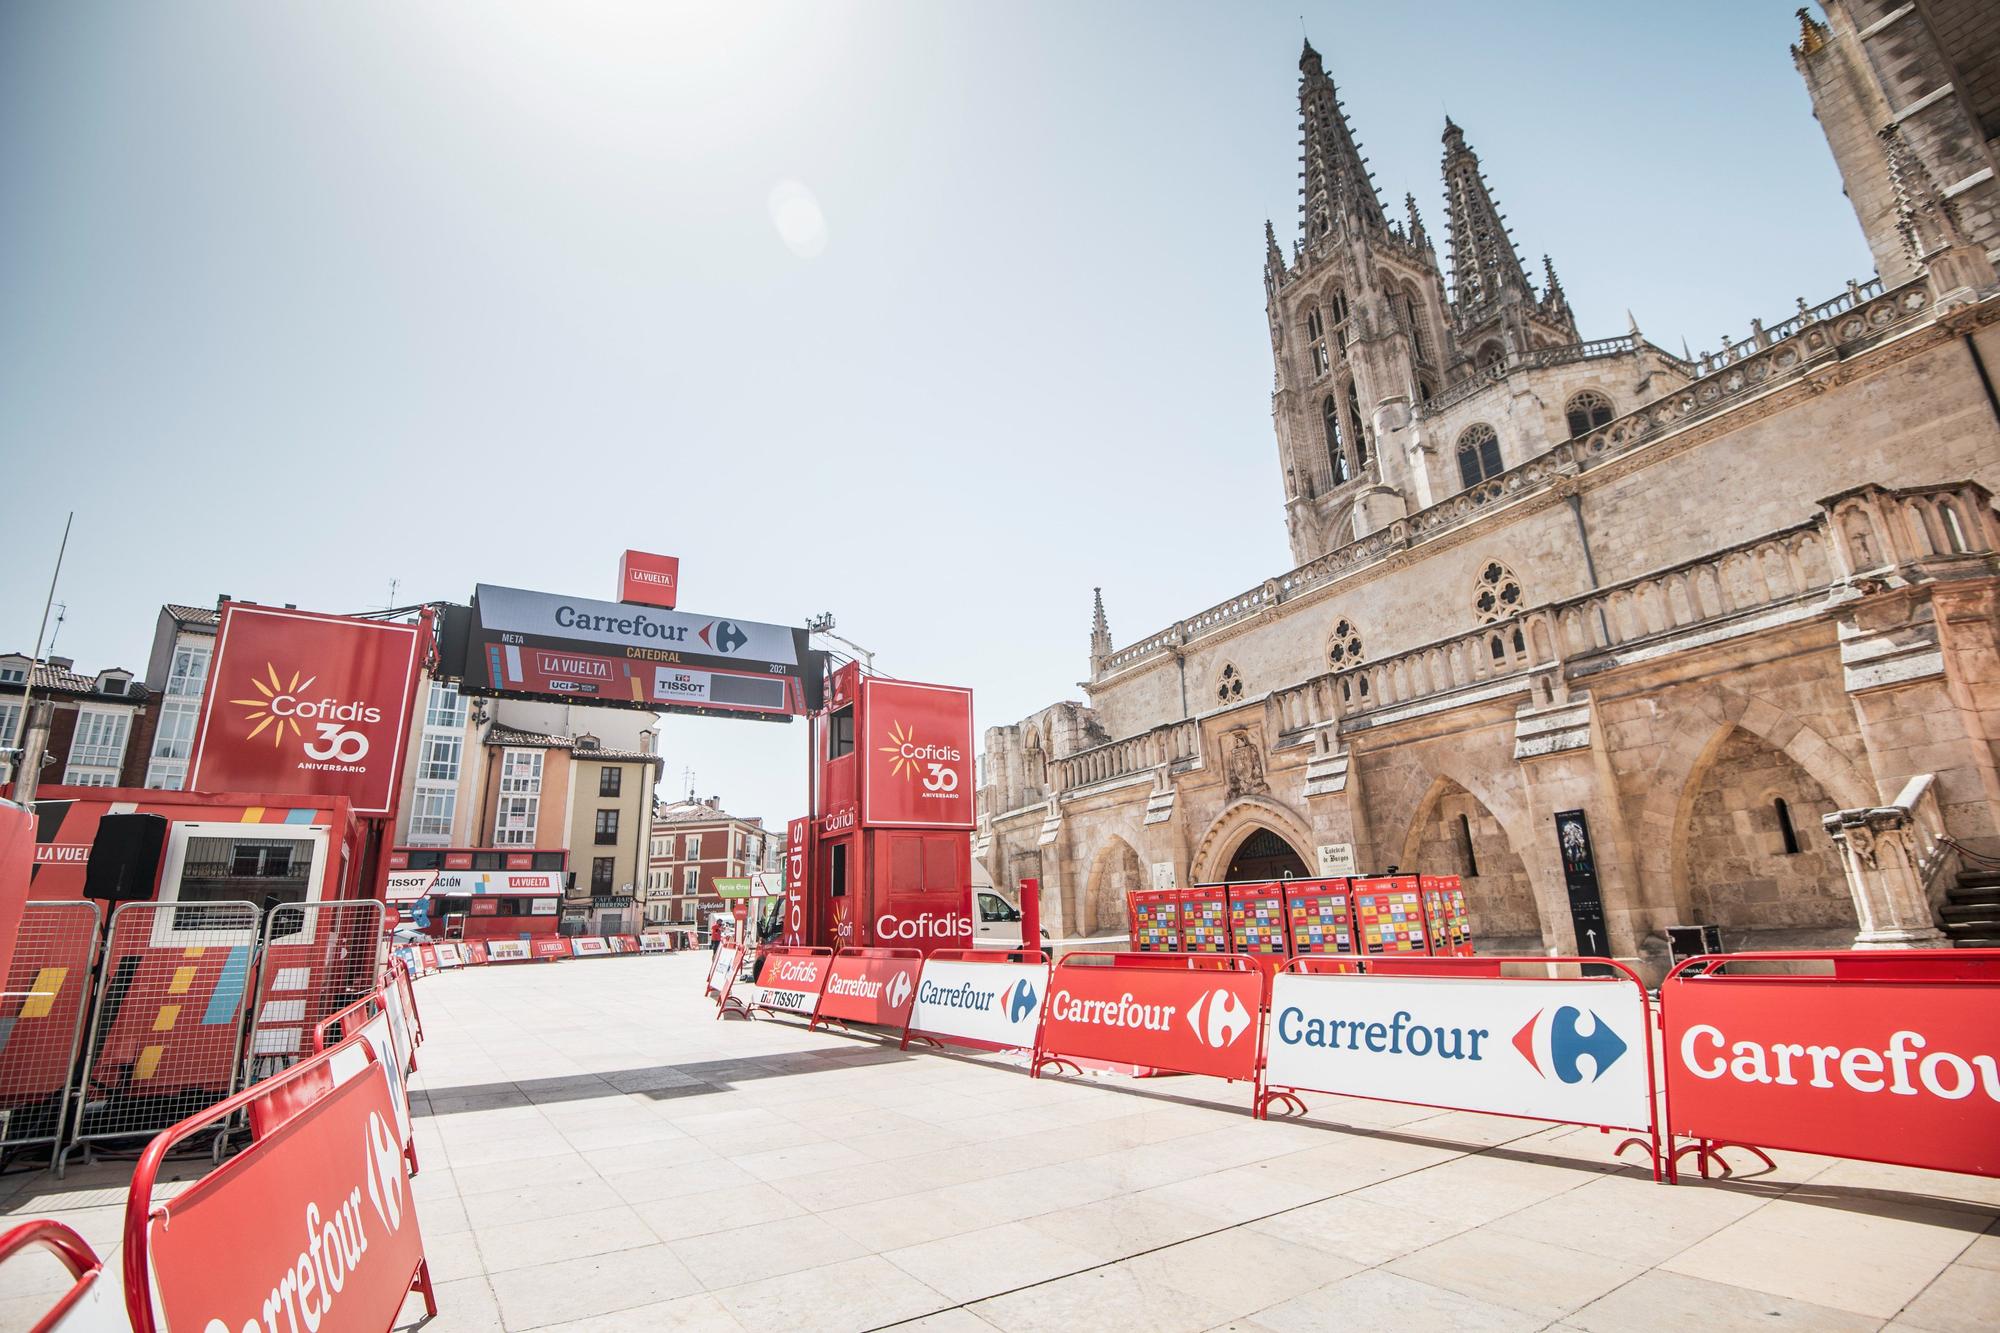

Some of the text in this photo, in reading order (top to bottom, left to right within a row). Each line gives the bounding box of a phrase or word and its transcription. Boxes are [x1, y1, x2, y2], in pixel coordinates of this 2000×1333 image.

[634, 570, 670, 585] LA VUELTA
[555, 605, 688, 642] Carrefour
[502, 633, 524, 645] META
[626, 647, 681, 664] CATEDRAL
[544, 657, 606, 676] LA VUELTA
[769, 663, 786, 675] 2021
[552, 681, 569, 690] UCI
[659, 680, 705, 693] TISSOT
[271, 695, 381, 723] Cofidis
[303, 722, 369, 763] 30
[900, 743, 961, 762] Cofidis
[298, 762, 366, 773] ANIVERSARIO
[922, 763, 958, 792] 30
[826, 806, 857, 832] Cofidi
[37, 846, 89, 861] LA VUEL
[511, 878, 521, 887] LA
[520, 878, 547, 887] VUELTA
[876, 912, 973, 940] Cofidis
[780, 960, 818, 984] Cofidis
[828, 972, 883, 1000] Carrefour
[920, 980, 994, 1012] Carrefour
[772, 991, 806, 1009] TISSOT
[1052, 990, 1176, 1032] Carrefour
[1278, 1006, 1489, 1061] Carrefour
[1680, 1024, 2000, 1103] Carrefo
